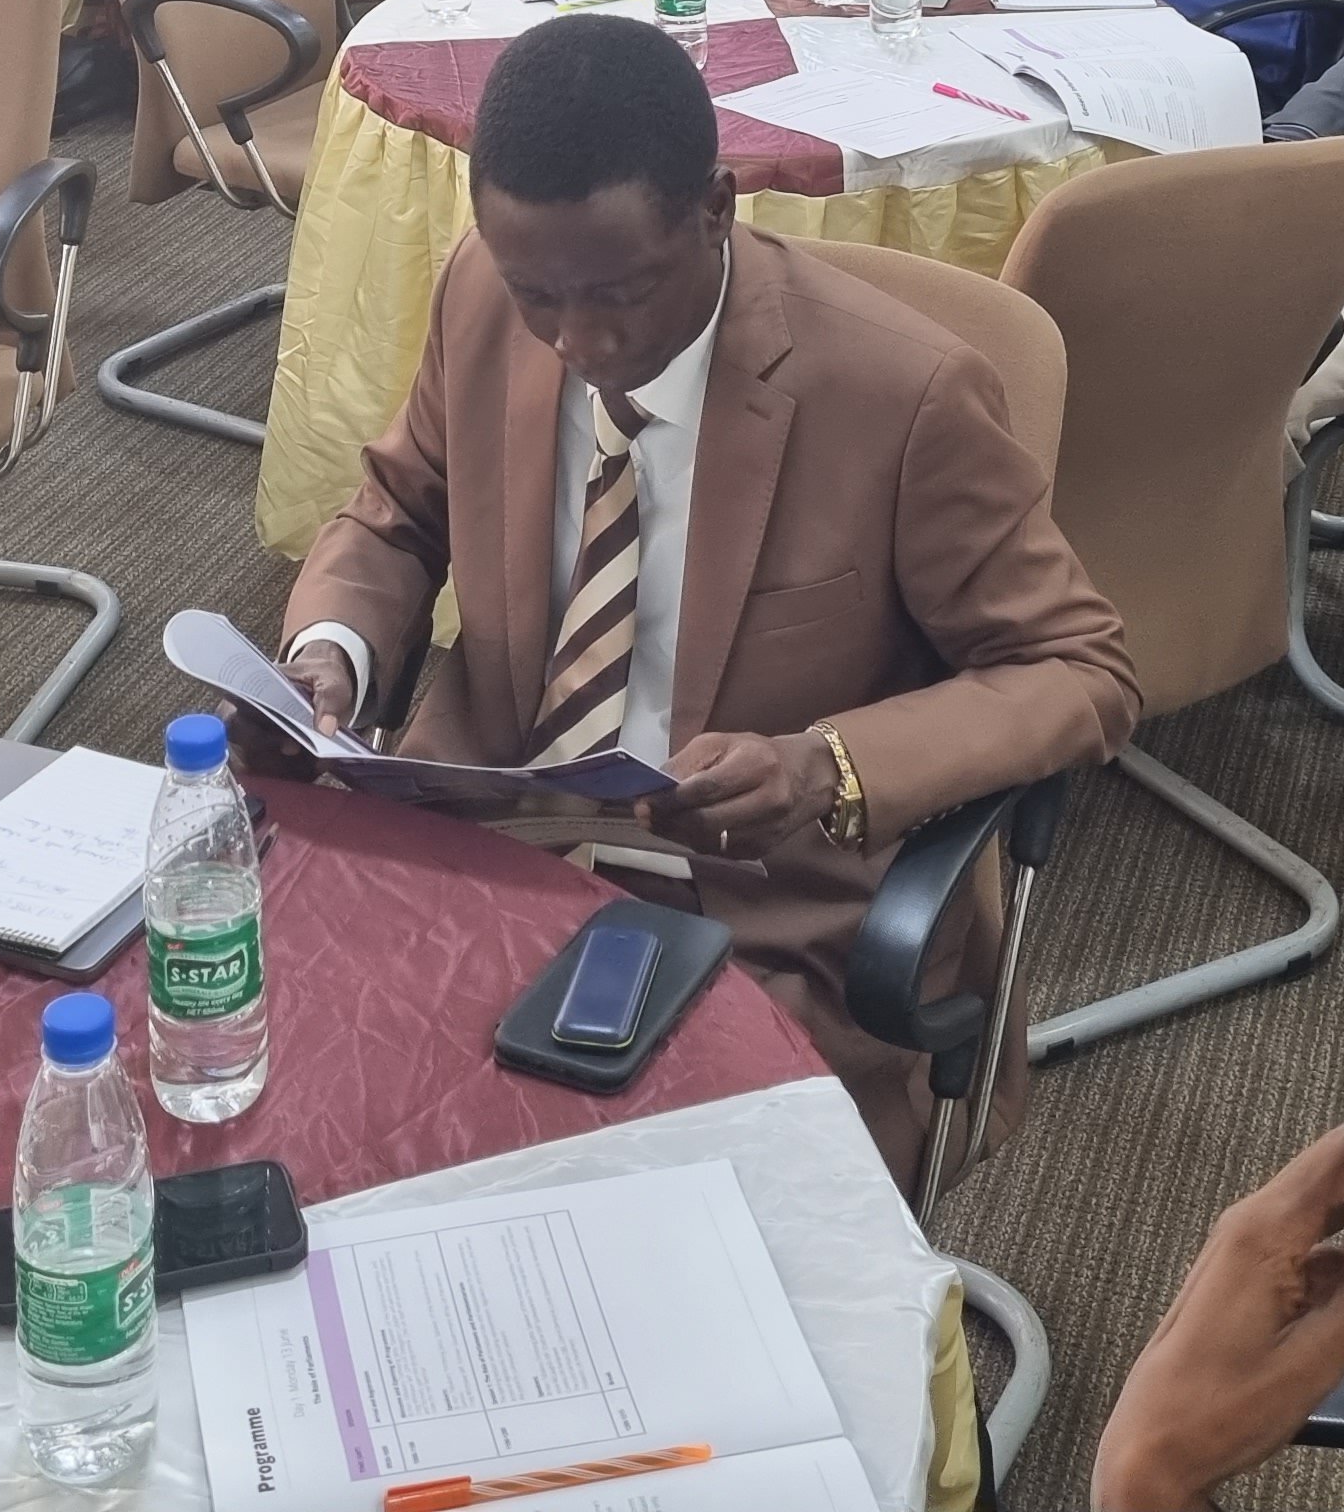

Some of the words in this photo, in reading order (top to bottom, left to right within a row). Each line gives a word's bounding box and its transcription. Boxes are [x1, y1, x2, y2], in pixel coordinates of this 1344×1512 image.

[303, 1335, 315, 1371] Parliaments
[286, 1360, 298, 1392] Monday
[247, 1407, 276, 1493] Programme
